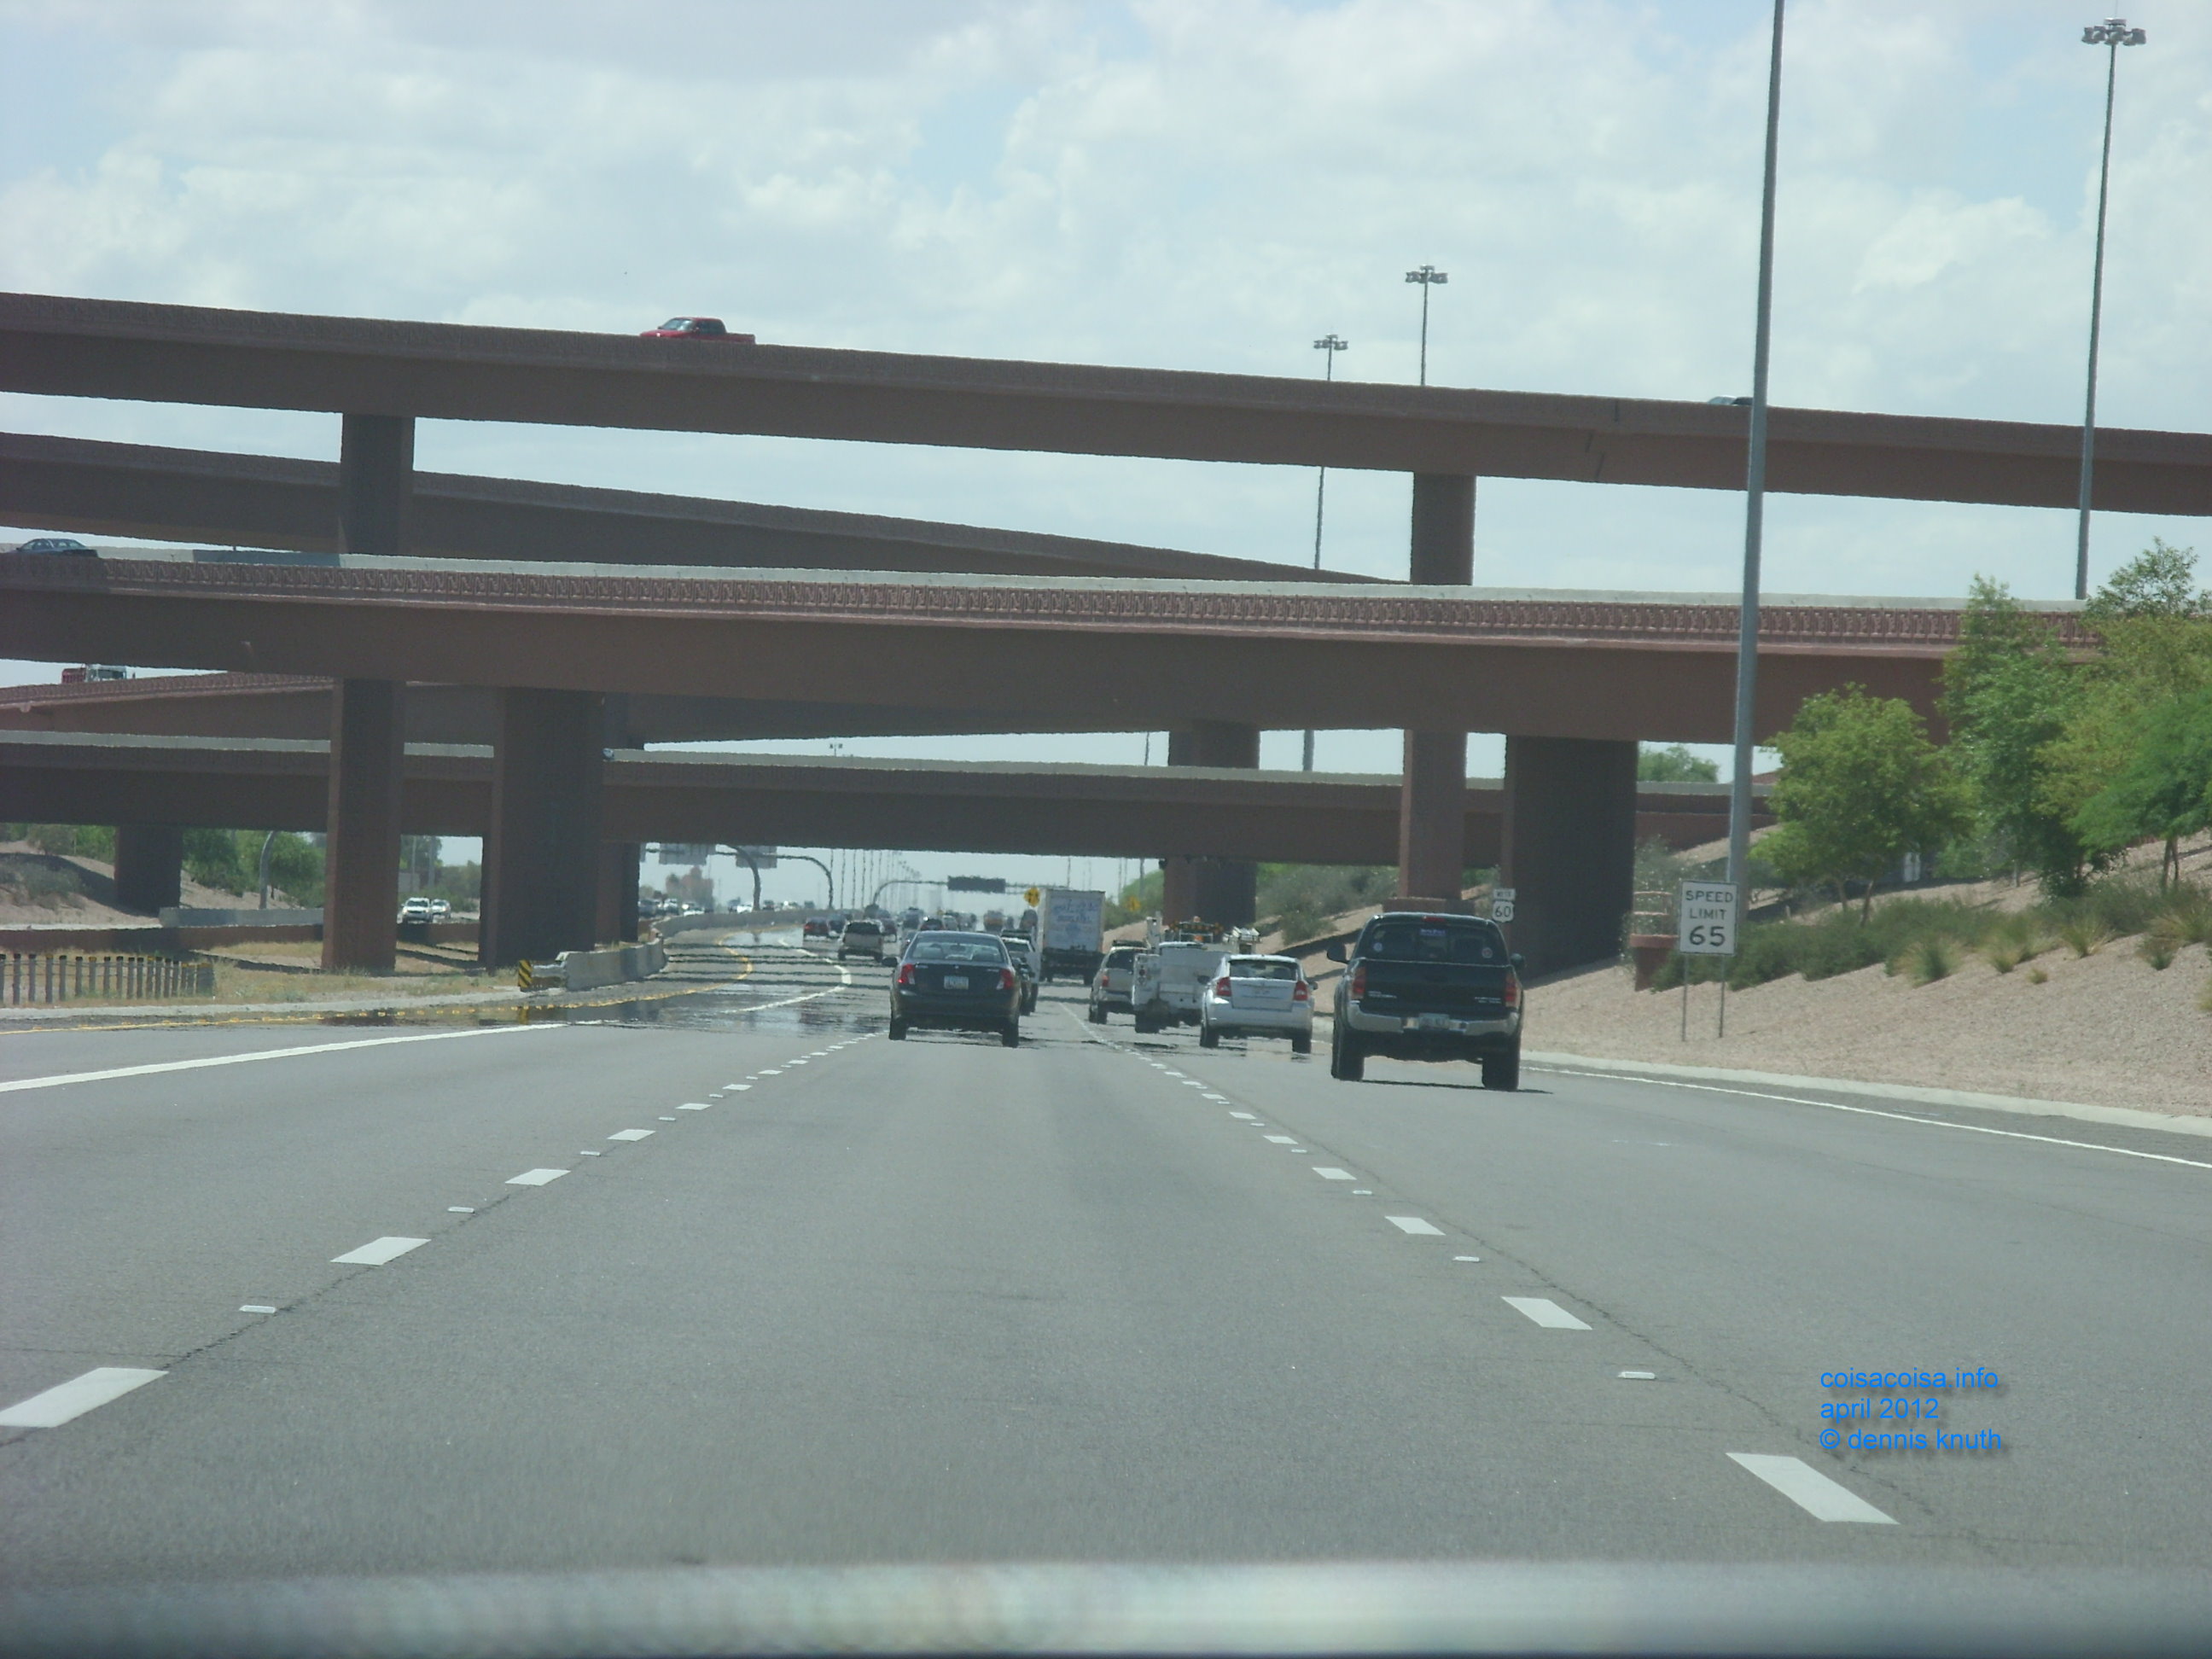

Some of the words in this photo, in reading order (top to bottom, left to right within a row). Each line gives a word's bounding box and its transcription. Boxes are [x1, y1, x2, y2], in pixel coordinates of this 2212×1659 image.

[1685, 890, 1733, 903] SPEED
[1495, 905, 1511, 917] 60
[1690, 908, 1727, 920] LIMIT
[1690, 925, 1726, 946] 65
